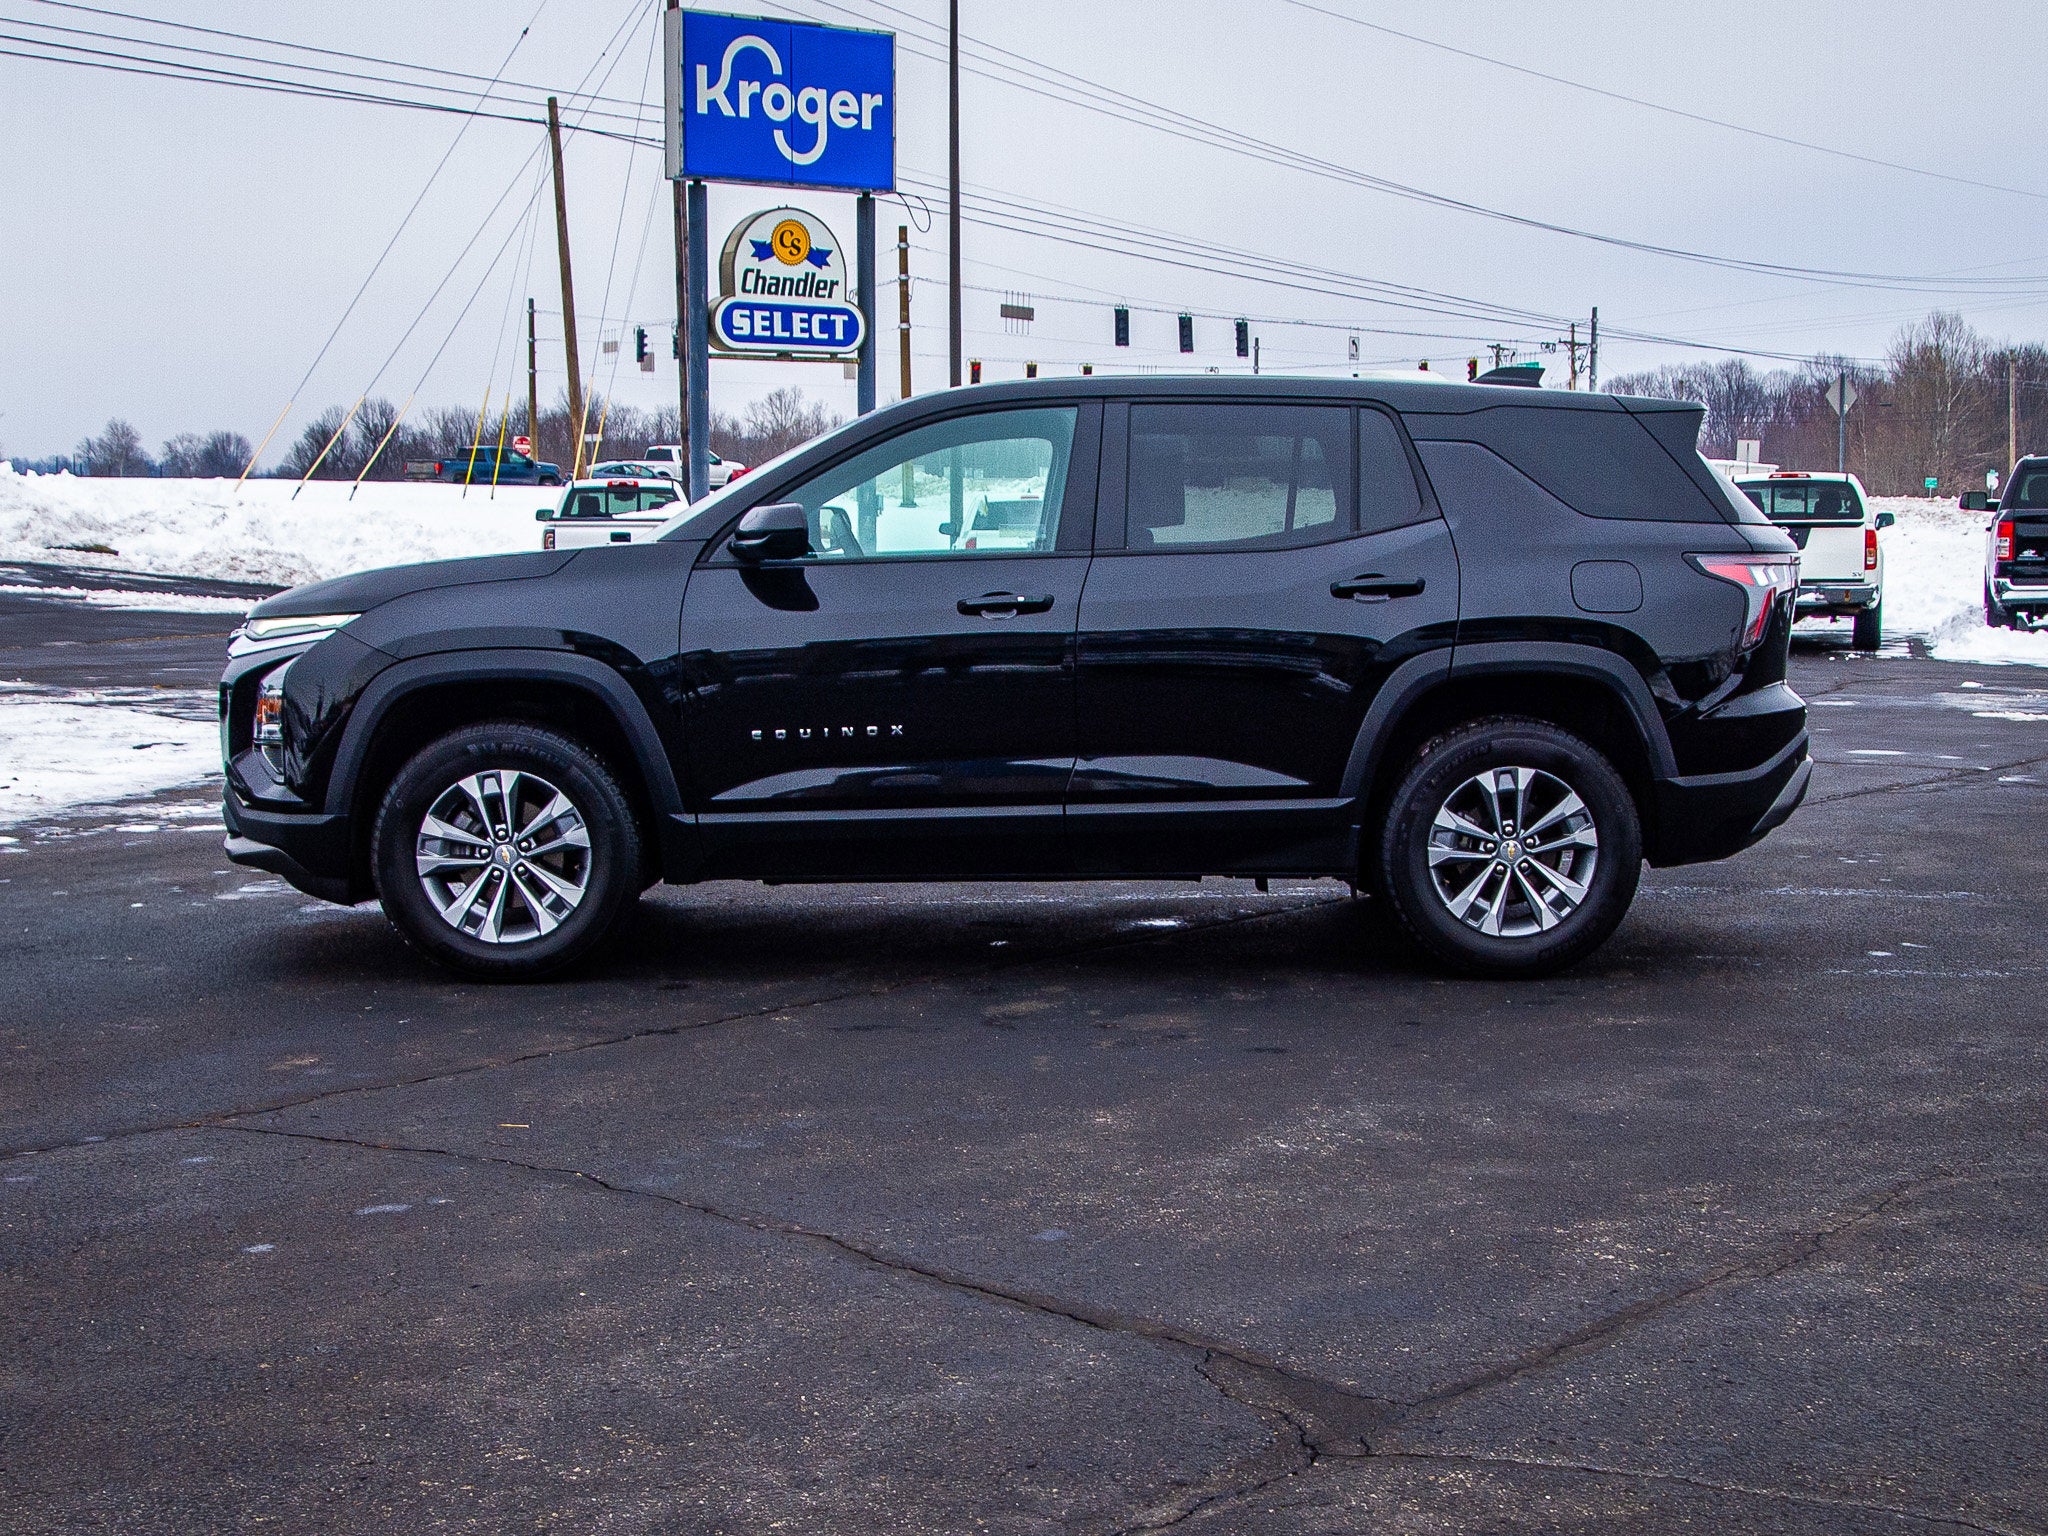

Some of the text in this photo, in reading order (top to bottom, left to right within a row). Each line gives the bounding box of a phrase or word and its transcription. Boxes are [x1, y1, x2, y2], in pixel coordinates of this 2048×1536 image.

[696, 35, 882, 165] Kroger
[779, 229, 802, 256] CS
[741, 268, 839, 298] Chandler
[732, 309, 849, 340] SELECT
[751, 724, 903, 740] EQUINOX
